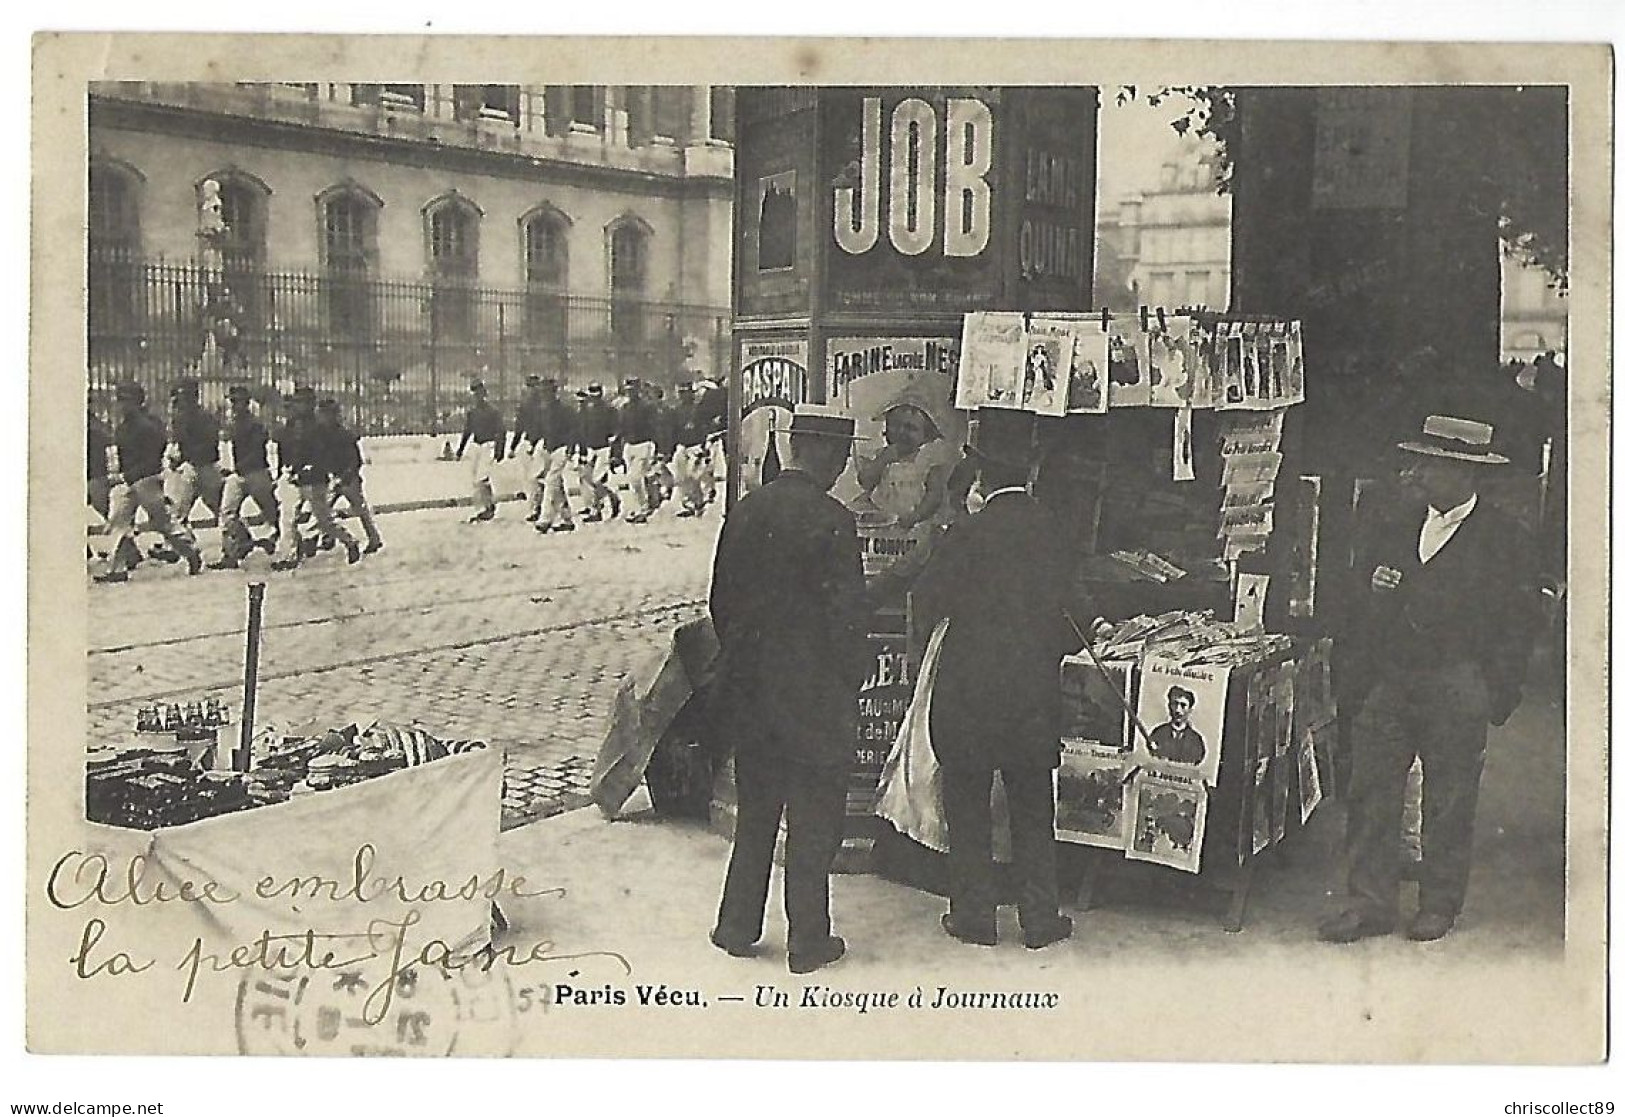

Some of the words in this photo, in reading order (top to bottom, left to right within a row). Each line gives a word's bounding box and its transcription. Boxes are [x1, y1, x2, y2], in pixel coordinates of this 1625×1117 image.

[834, 97, 993, 257] JOB
[832, 345, 892, 398] FARINE
[47, 850, 241, 909] Alice
[255, 843, 567, 902] embrasse
[69, 917, 155, 979] la
[177, 929, 384, 1003] petite
